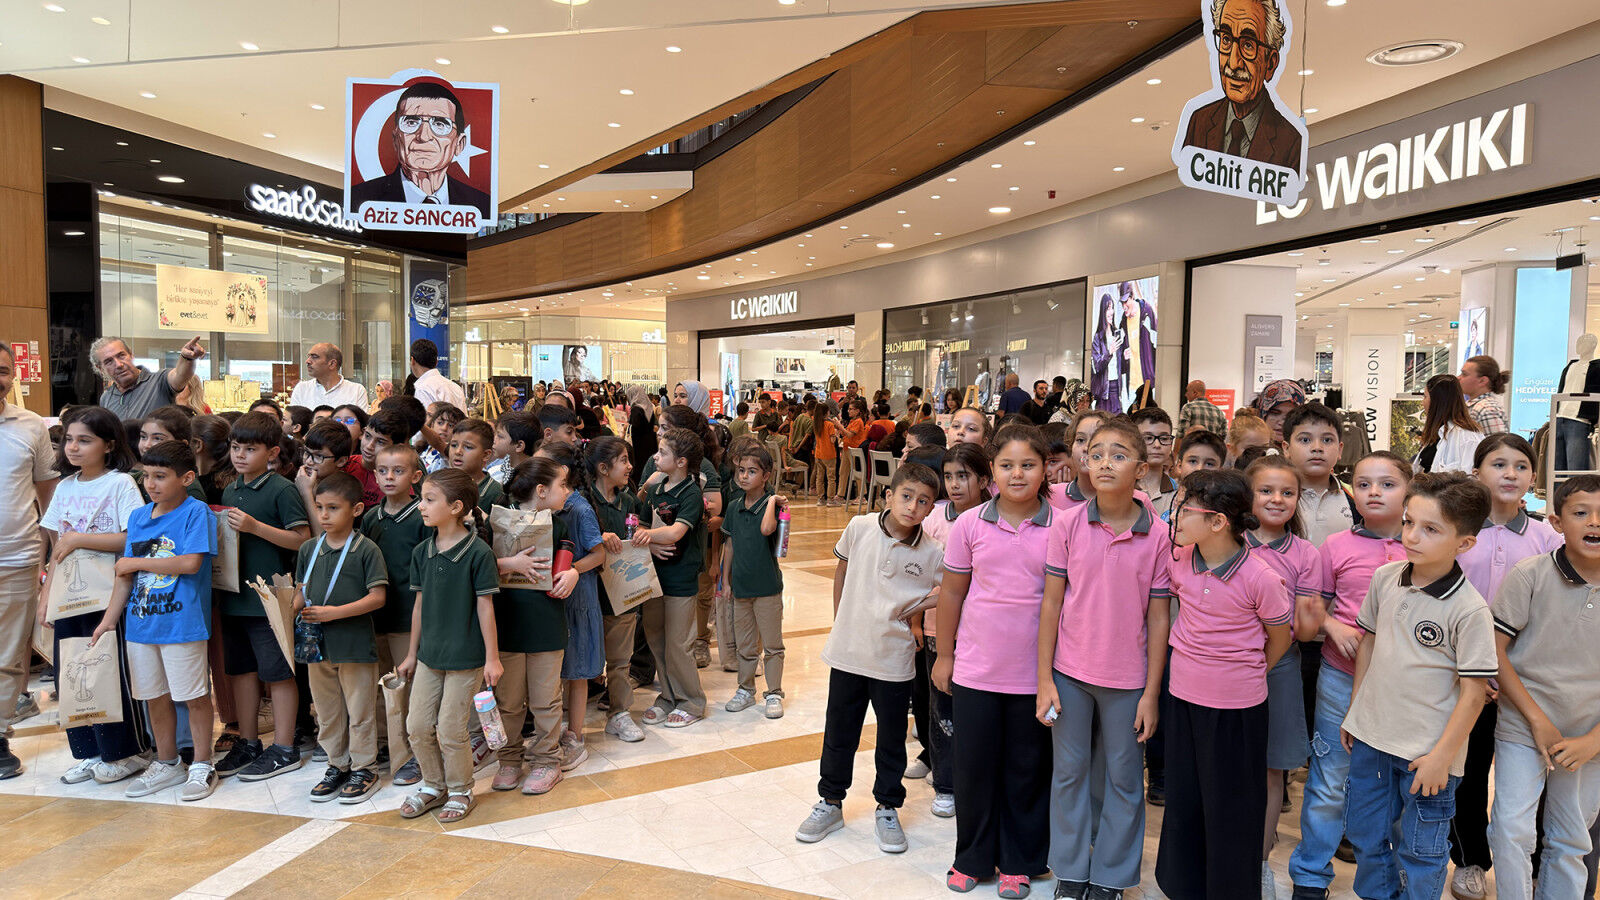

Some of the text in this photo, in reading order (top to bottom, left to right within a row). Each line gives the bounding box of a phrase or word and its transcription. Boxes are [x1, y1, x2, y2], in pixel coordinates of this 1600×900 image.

[1190, 152, 1290, 198] Cahit ARF
[363, 206, 477, 227] Aziz SANCAR
[730, 298, 748, 320] LC
[1366, 347, 1380, 401] VISION
[1515, 386, 1558, 395] HEDİYELE
